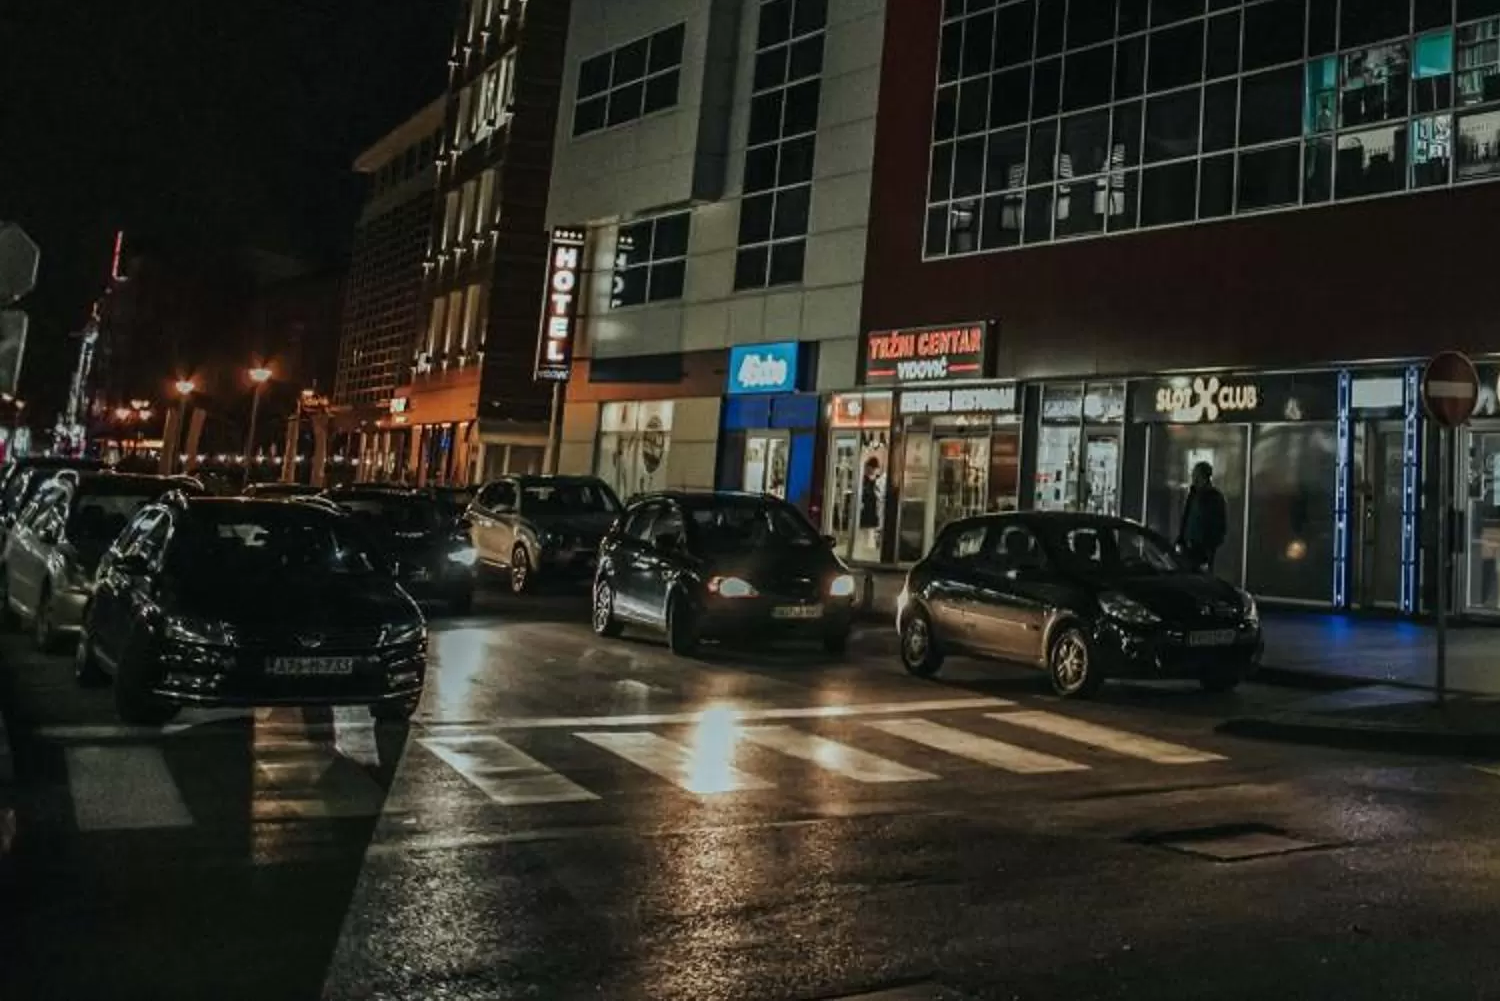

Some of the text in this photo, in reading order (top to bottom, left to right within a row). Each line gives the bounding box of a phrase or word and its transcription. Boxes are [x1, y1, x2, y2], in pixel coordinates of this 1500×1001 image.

[547, 246, 578, 361] HOTEL
[917, 327, 982, 356] CENTAR
[1155, 386, 1193, 412] SLOT
[1217, 385, 1258, 410] CLUB
